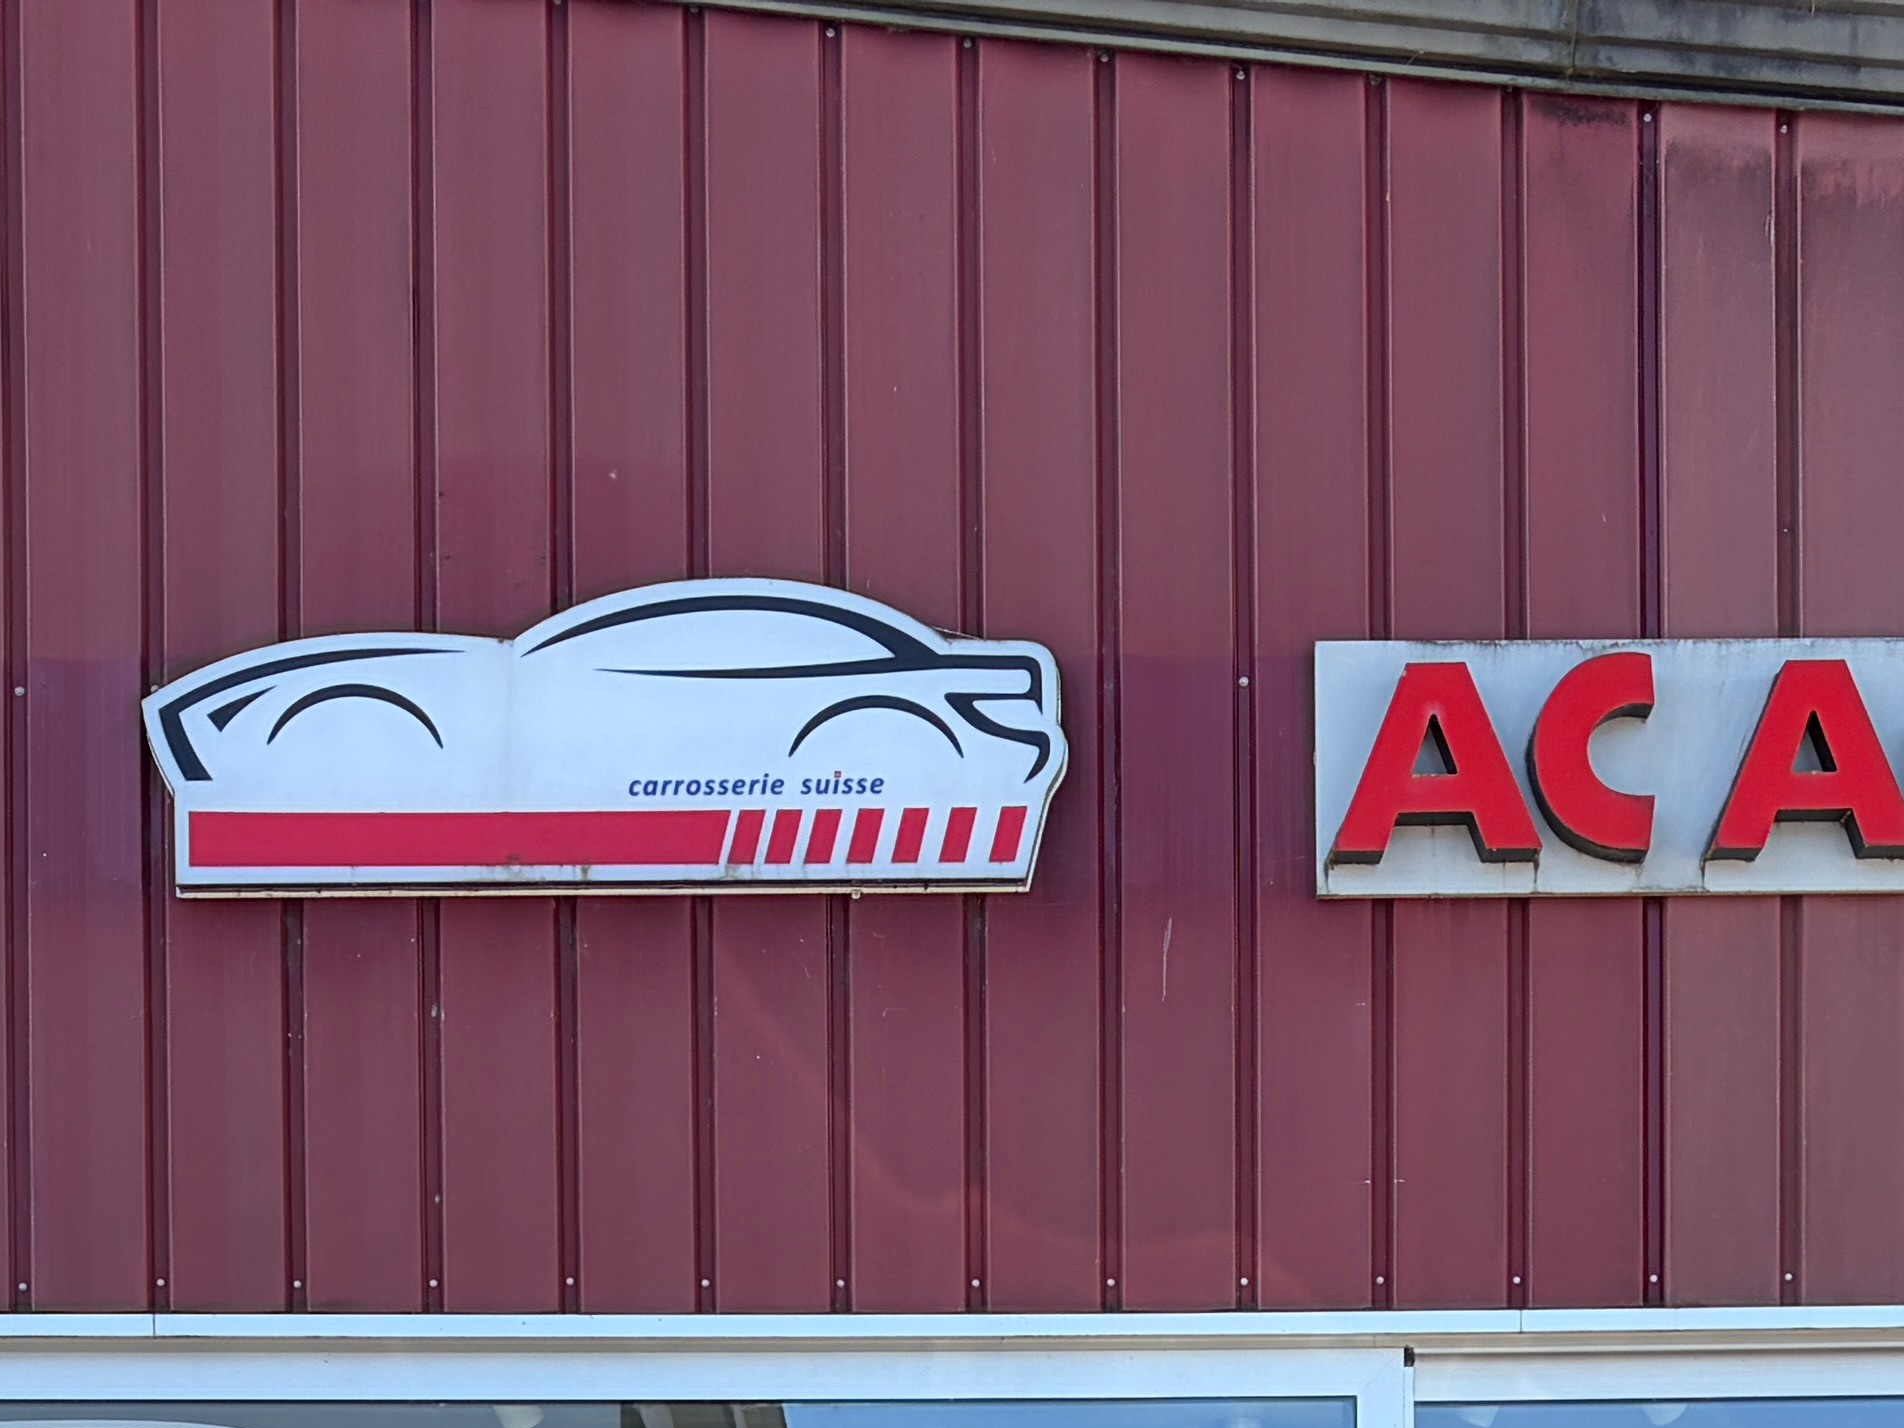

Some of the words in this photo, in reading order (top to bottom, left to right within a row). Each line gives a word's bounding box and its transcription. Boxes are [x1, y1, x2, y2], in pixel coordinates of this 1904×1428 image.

[628, 771, 785, 797] carrosserie
[801, 770, 885, 796] suisse
[1327, 651, 1656, 864] AC
